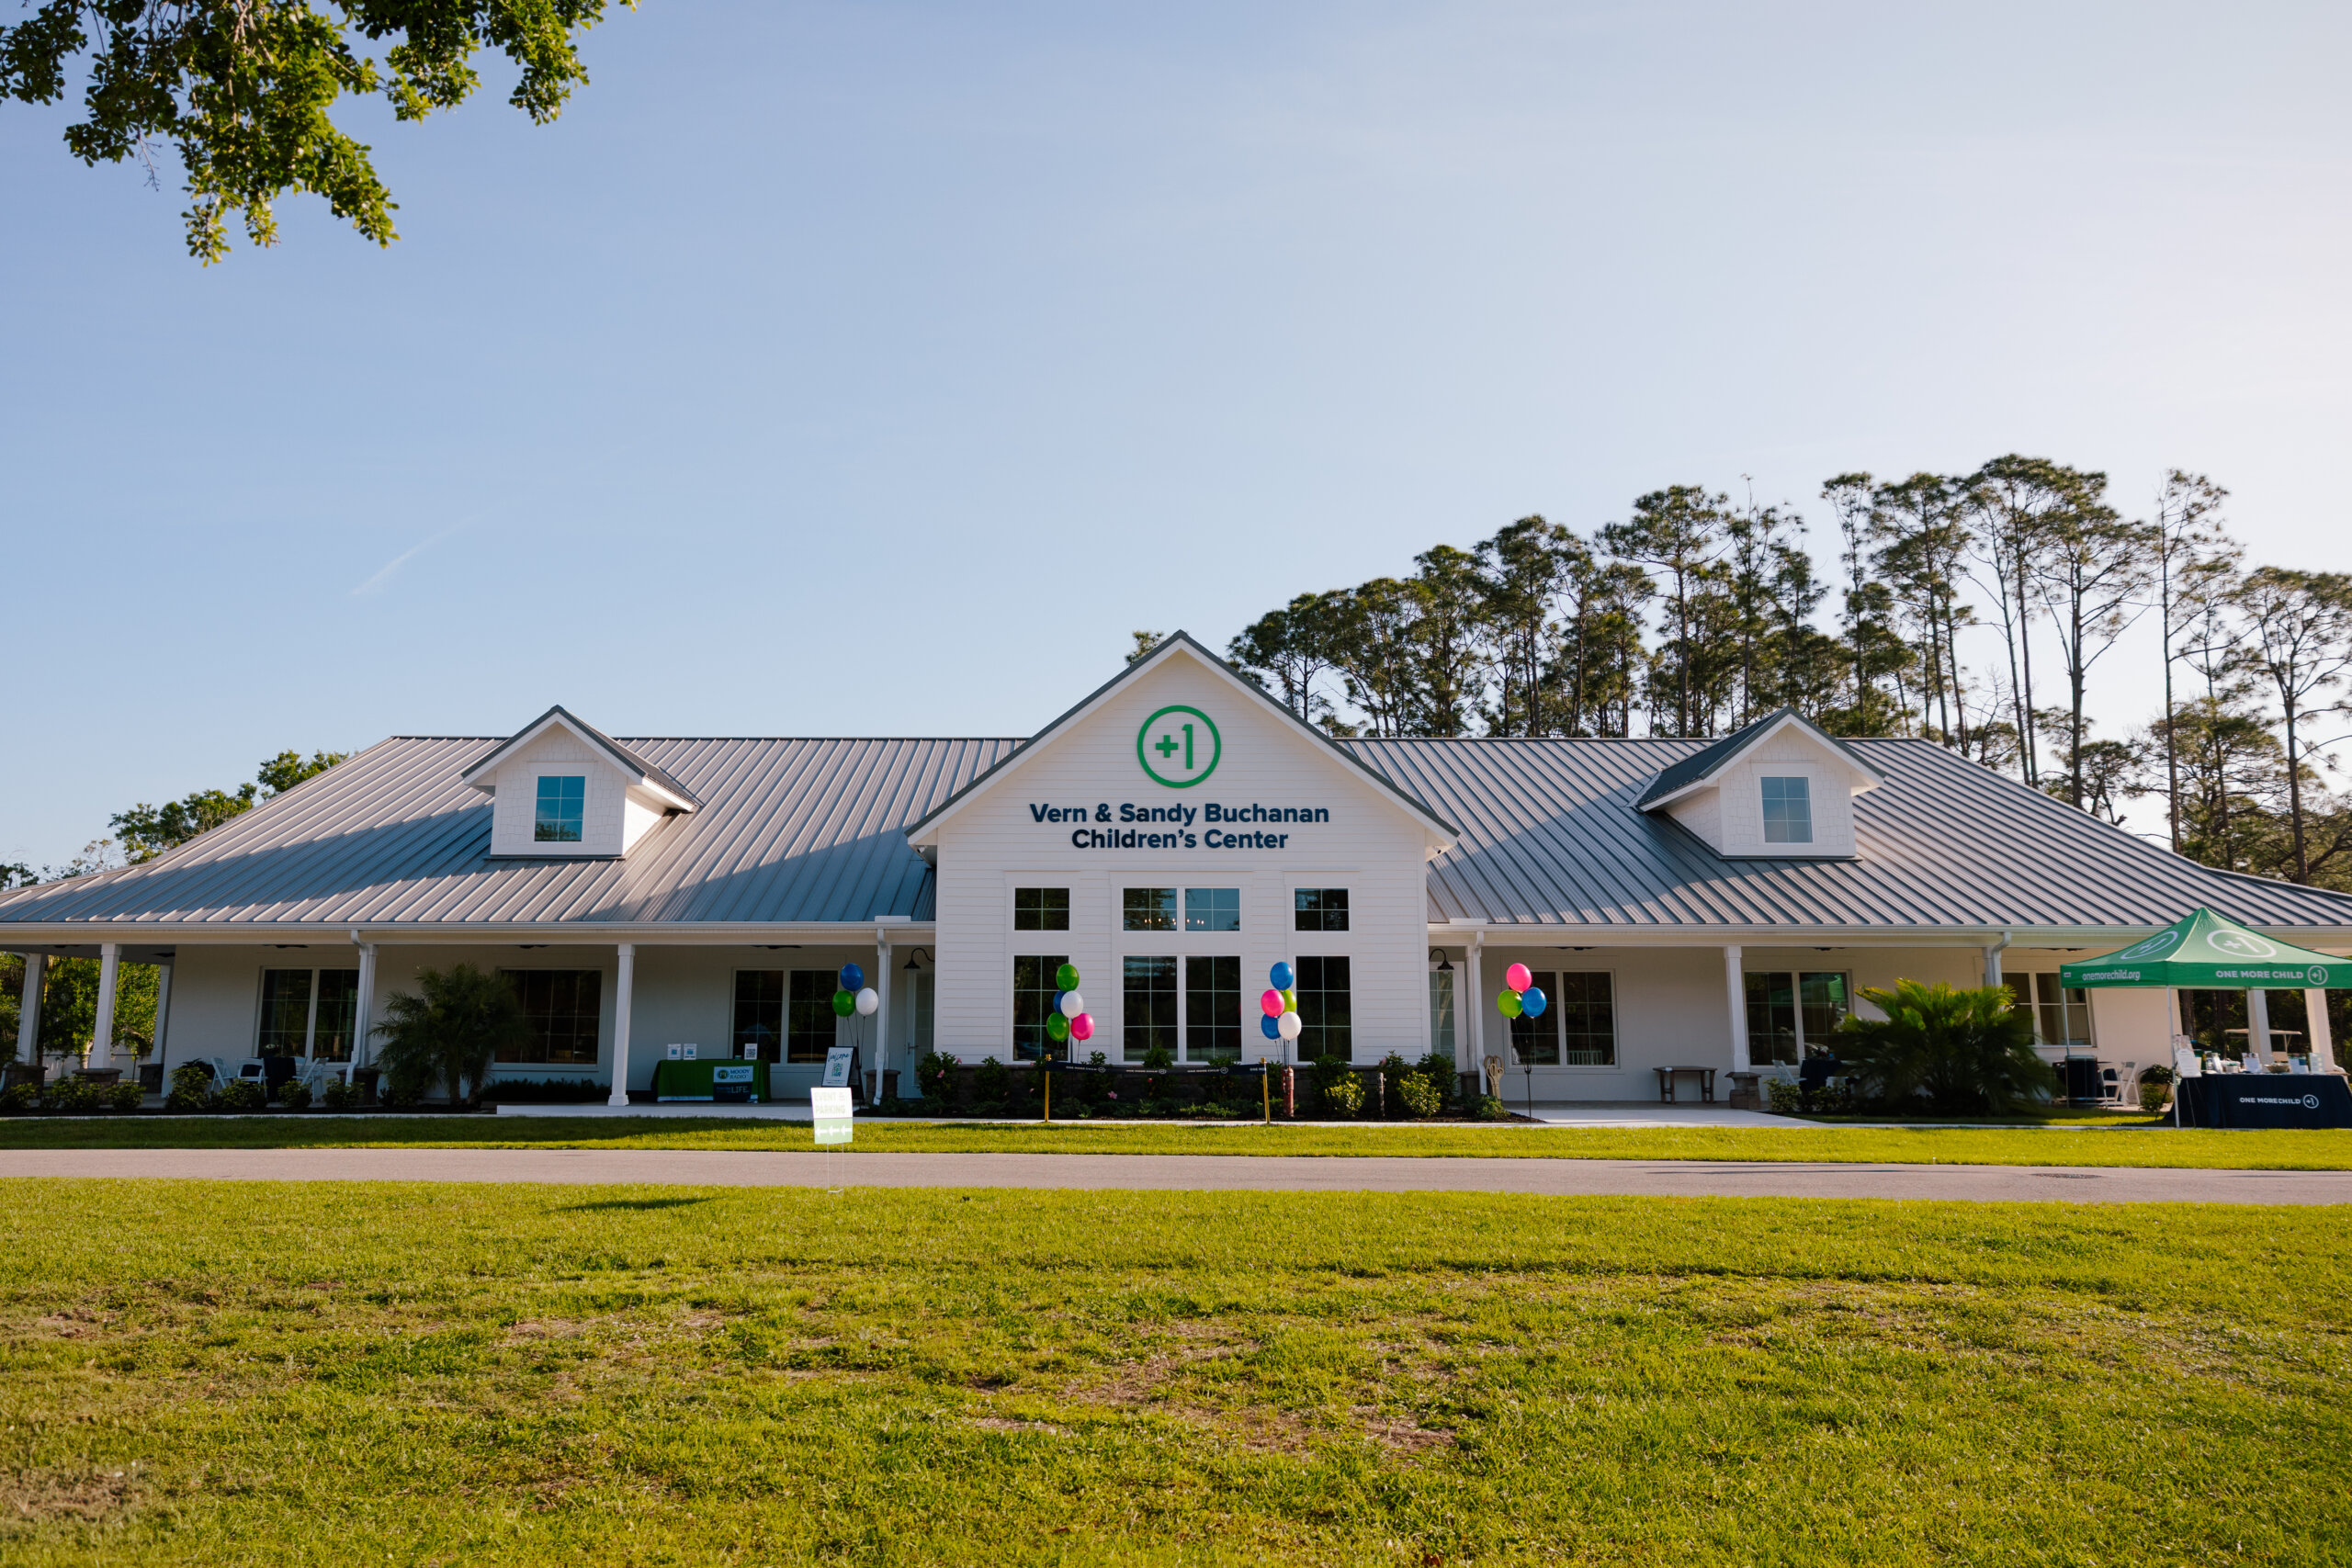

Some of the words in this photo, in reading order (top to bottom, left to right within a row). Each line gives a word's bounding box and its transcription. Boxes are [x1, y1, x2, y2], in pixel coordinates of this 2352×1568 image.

[1029, 803, 1088, 823] Vern
[1094, 803, 1113, 823] &
[1119, 802, 1198, 827] Sandy
[1204, 803, 1329, 823] Buchanan
[1071, 829, 1197, 849] Children's
[1204, 829, 1289, 849] Center
[2082, 969, 2141, 981] onemorechild.org
[2215, 970, 2239, 978] ONE
[2240, 970, 2270, 979] MORE
[2272, 971, 2304, 979] CHILD
[815, 1104, 846, 1114] PARKING
